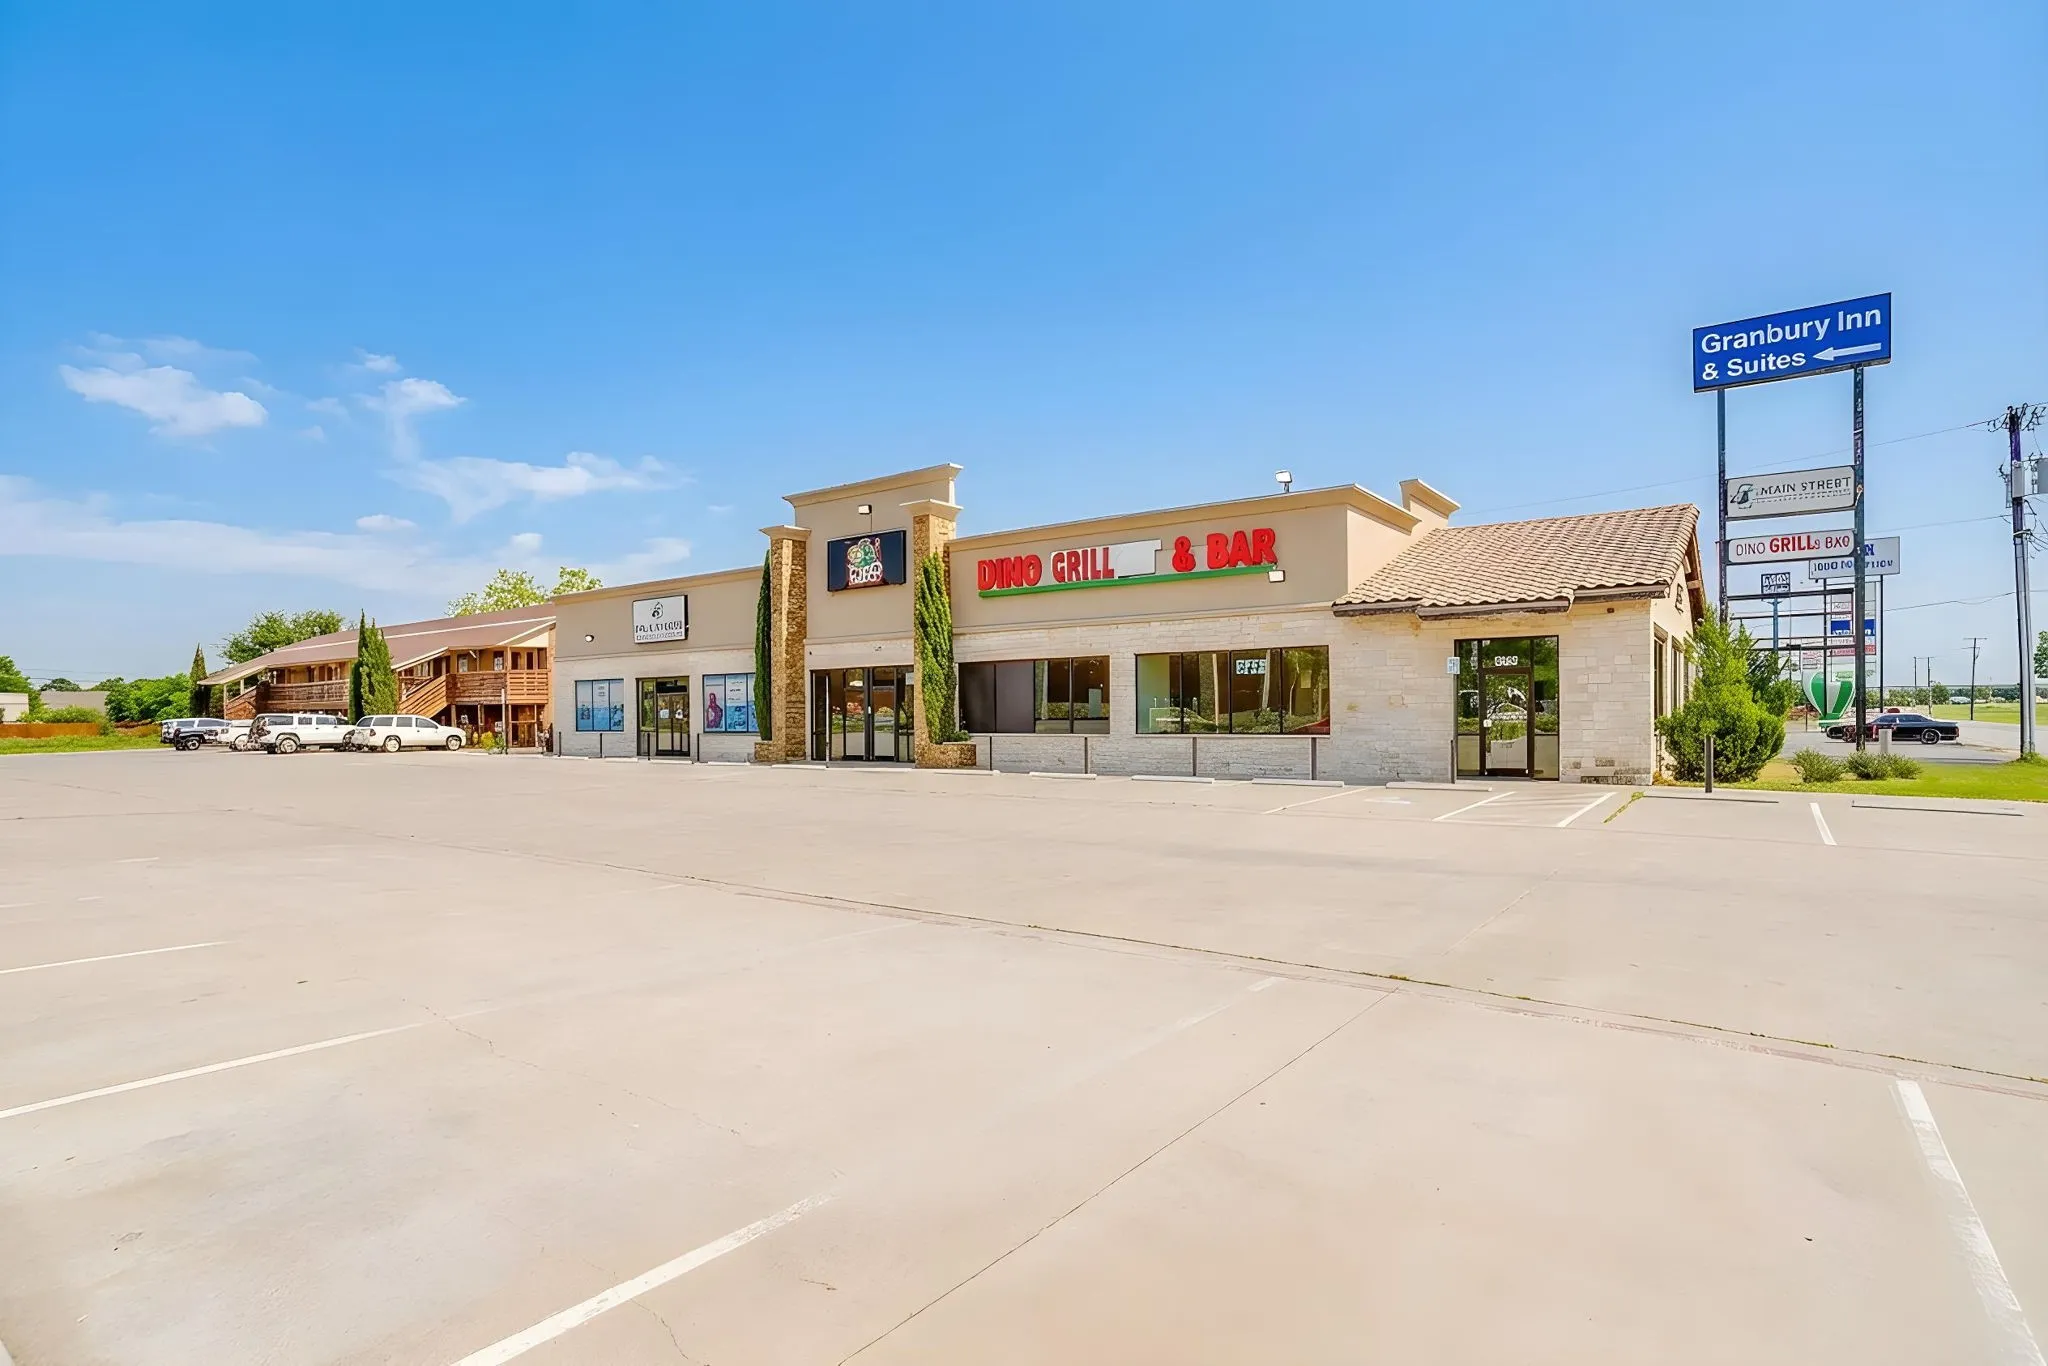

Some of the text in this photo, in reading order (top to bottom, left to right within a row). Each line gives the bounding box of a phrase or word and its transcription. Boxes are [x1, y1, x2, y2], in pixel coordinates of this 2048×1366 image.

[1701, 308, 1881, 353] Granbury Inn
[1702, 352, 1806, 381] & Suites
[1760, 483, 1796, 496] MAIN
[978, 528, 1277, 591] DINO GRILL & BAR
[1736, 542, 1766, 556] DINO
